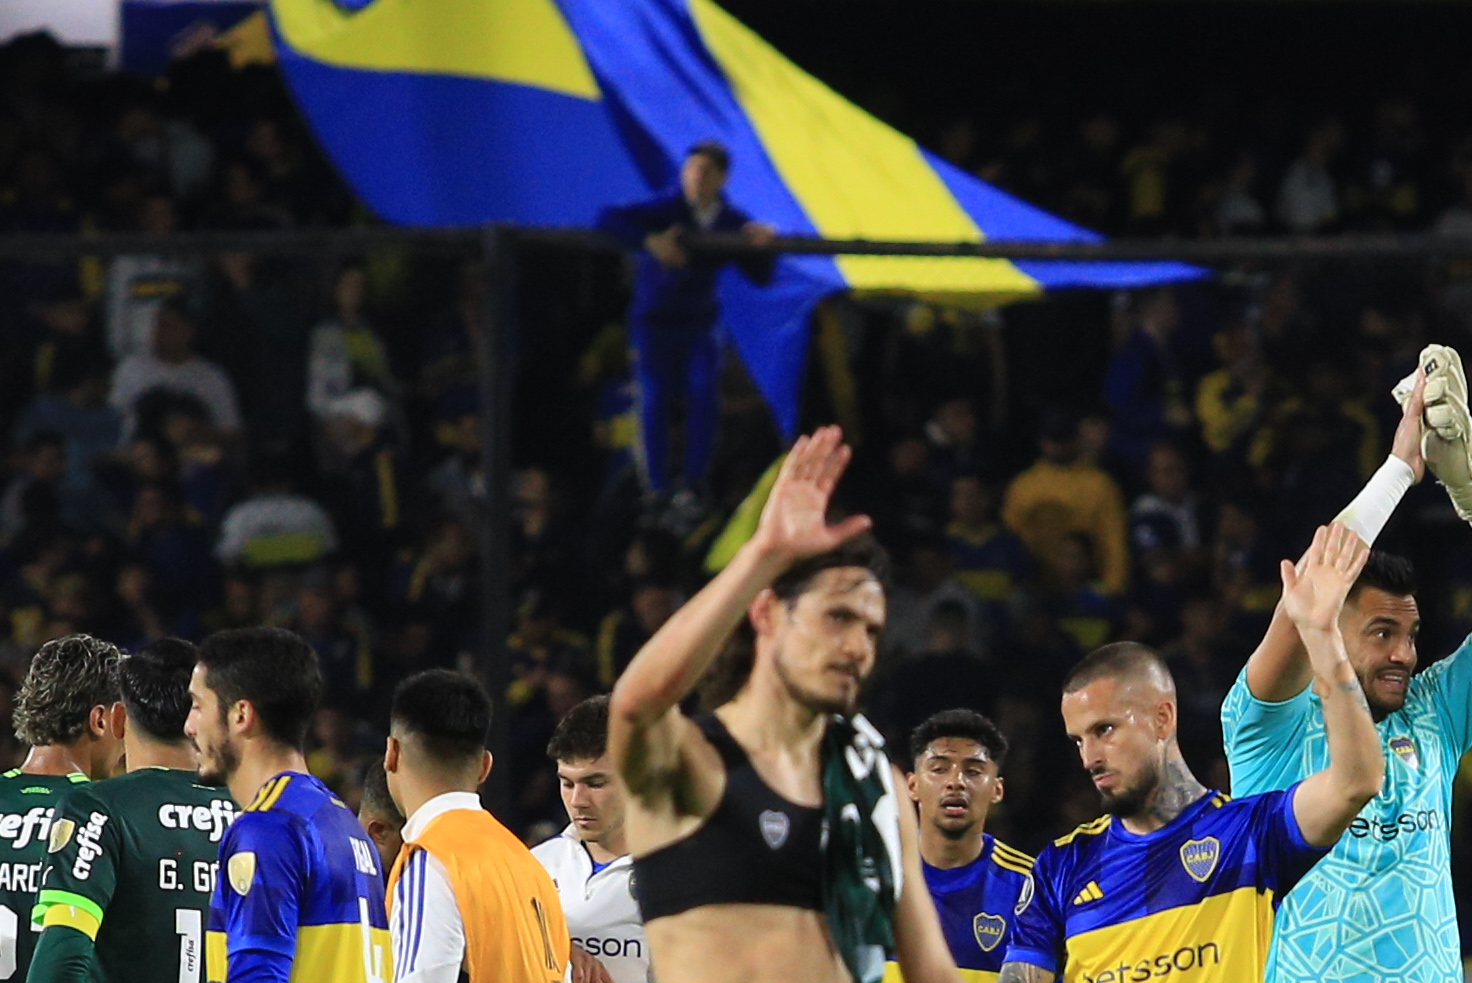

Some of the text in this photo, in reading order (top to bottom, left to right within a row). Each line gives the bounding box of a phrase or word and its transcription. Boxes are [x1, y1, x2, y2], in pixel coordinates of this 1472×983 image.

[1349, 809, 1440, 843] etsson
[72, 811, 109, 881] crefisa
[158, 858, 185, 890] G.
